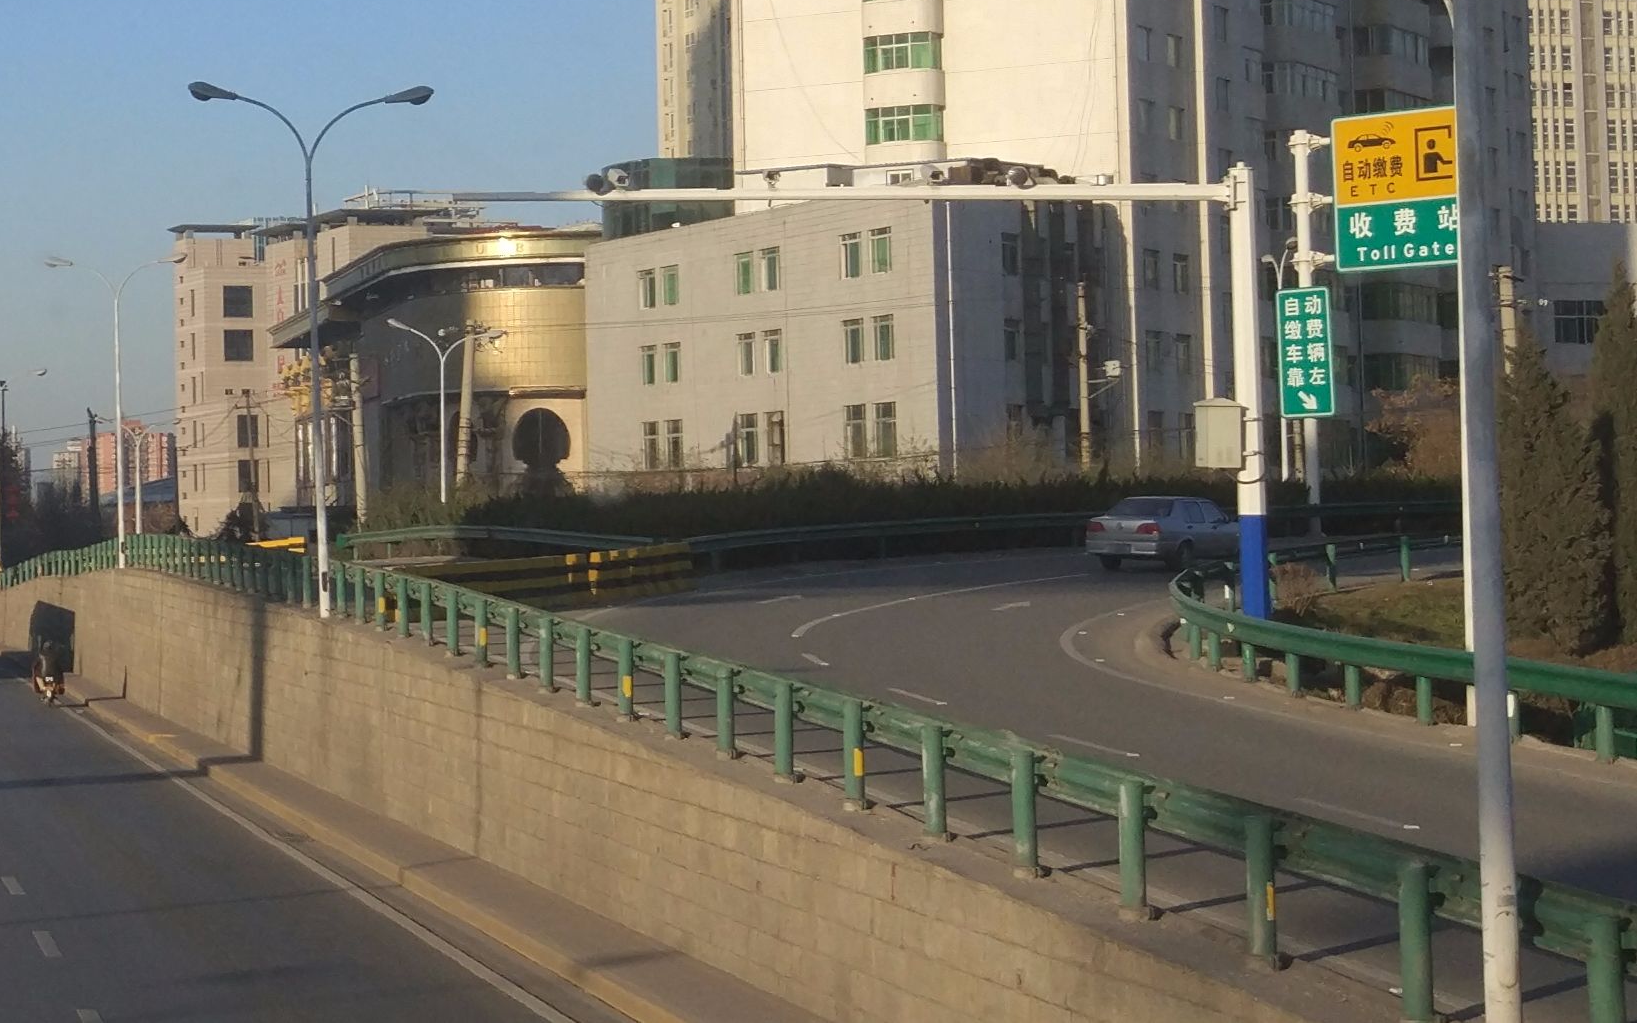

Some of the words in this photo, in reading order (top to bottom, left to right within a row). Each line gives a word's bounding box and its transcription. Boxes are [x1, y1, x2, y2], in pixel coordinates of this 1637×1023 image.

[1343, 156, 1403, 182] 自动缴费
[1356, 245, 1396, 262] Toll
[1403, 241, 1455, 258] Gate
